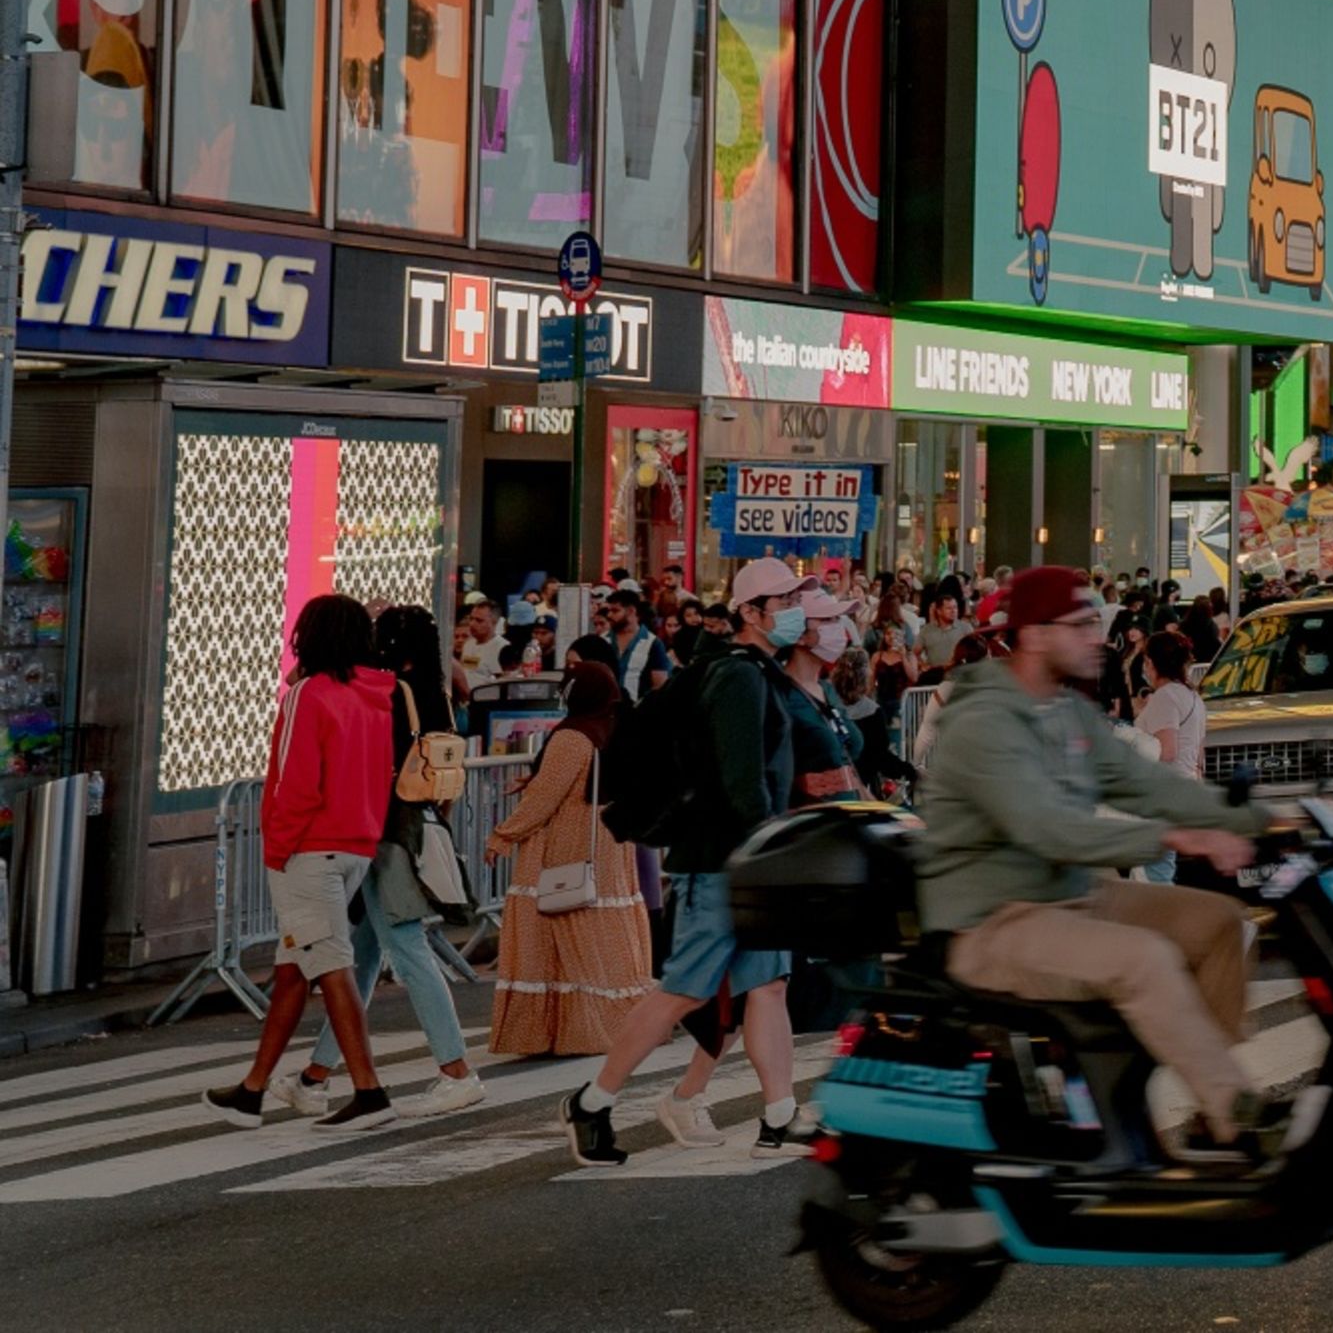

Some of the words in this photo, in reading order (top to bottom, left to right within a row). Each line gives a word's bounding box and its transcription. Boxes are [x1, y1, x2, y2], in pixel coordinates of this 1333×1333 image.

[1158, 89, 1220, 162] BT21
[17, 229, 316, 342] CHERS
[496, 290, 650, 369] TIOT
[732, 331, 753, 363] the
[756, 335, 797, 368] Italian
[798, 343, 870, 375] countryside
[914, 345, 957, 392] LINE
[958, 347, 1030, 399] FRIENDS
[1050, 360, 1088, 403] NEW
[1092, 362, 1133, 407] YORK
[1150, 371, 1182, 410] LINE
[778, 403, 829, 440] KIKO
[739, 468, 792, 499] Type
[804, 470, 827, 496] it
[835, 471, 858, 498] in
[738, 508, 775, 534] see
[781, 506, 849, 534] videos
[215, 848, 226, 908] NYPD
